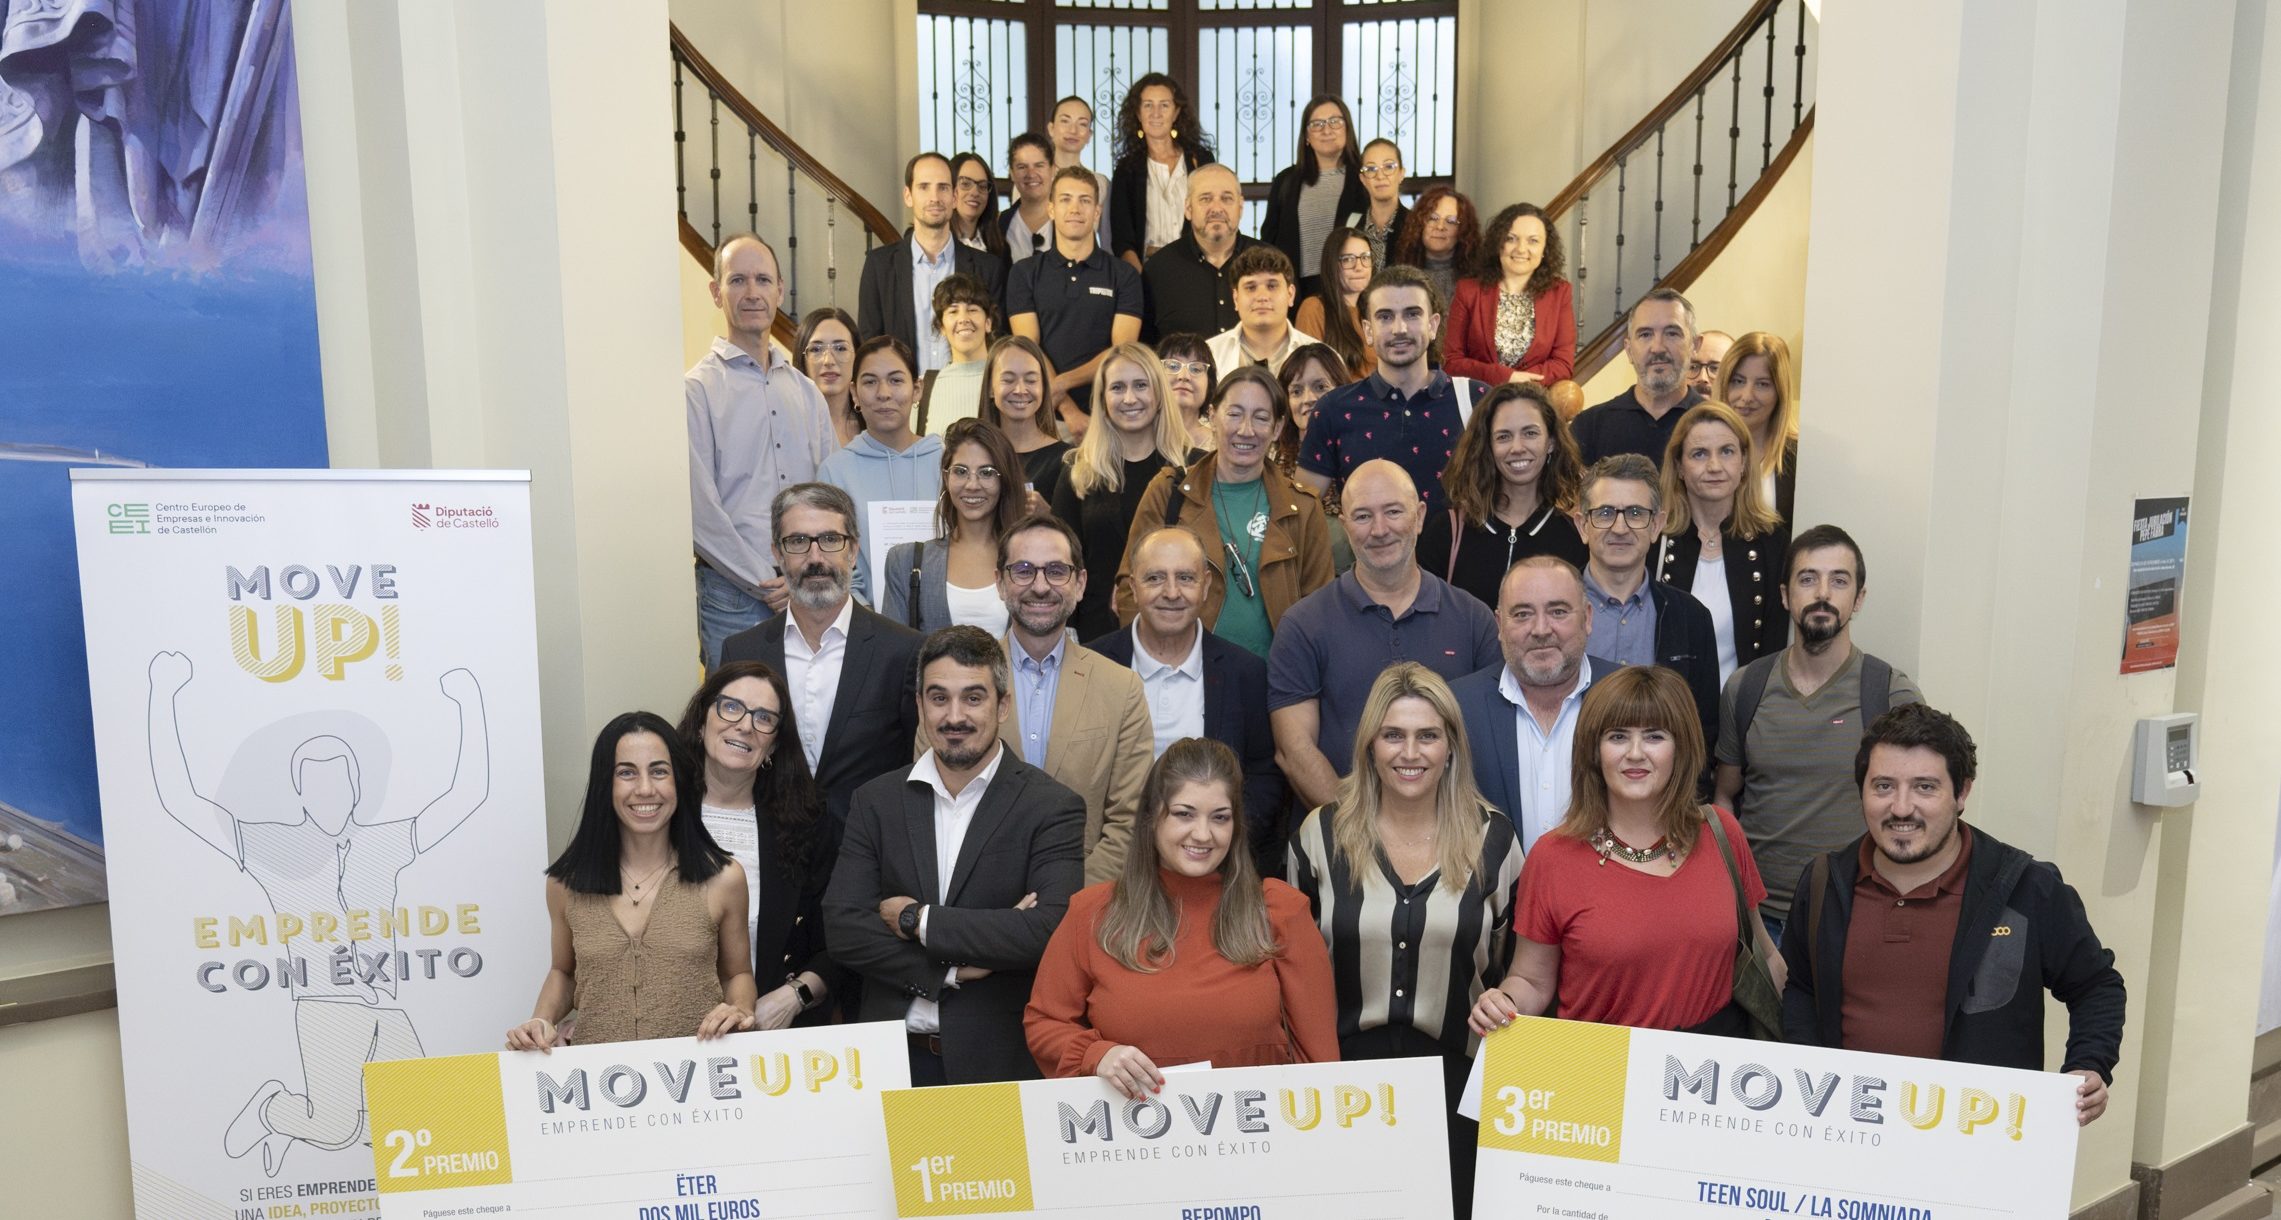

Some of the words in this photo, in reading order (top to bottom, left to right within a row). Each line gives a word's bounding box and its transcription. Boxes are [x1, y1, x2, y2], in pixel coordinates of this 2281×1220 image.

[155, 503, 189, 512] Centro
[191, 503, 232, 514] Europeo
[233, 503, 247, 512] de
[156, 514, 203, 524] Empresas
[213, 513, 265, 523] Innovación
[435, 506, 493, 518] Diputació
[157, 525, 170, 534] de
[172, 525, 217, 534] Castellón
[436, 518, 451, 528] de
[453, 517, 499, 529] Castelló
[224, 564, 399, 600] MOVE
[228, 604, 404, 684] UP!
[193, 903, 481, 948] EMPRENDE
[196, 956, 308, 993] CON
[329, 944, 483, 986] ÉXITO
[541, 1115, 638, 1136] EMPRENDE
[647, 1111, 683, 1127] CON
[692, 1106, 744, 1124] ÉXITO
[1531, 1118, 1611, 1147] PREMIO
[1659, 1108, 1764, 1133] EMPRENDE
[1774, 1121, 1815, 1139] CON
[1824, 1125, 1883, 1147] ÉXITO
[423, 1150, 499, 1176] PREMIO
[1062, 1145, 1162, 1165] EMPRENDE
[1171, 1144, 1208, 1158] CON
[1217, 1140, 1271, 1156] ÉXITO
[239, 1188, 253, 1203] SI
[257, 1184, 293, 1201] ERES
[297, 1178, 378, 1197] EMPRENDE
[676, 1173, 718, 1197] ËTER
[940, 1179, 1016, 1201] PREMIO
[1519, 1172, 1553, 1185] Páguese
[1555, 1178, 1573, 1187] este
[1574, 1179, 1604, 1192] cheque
[1605, 1184, 1611, 1192] a
[423, 1208, 456, 1219] Páguese
[457, 1206, 475, 1216] este
[476, 1204, 504, 1216] cheque
[639, 1205, 671, 1220] DOS
[675, 1203, 704, 1220] MIL
[707, 1198, 761, 1220] EUROS
[1697, 1181, 1742, 1206] TEEN
[1745, 1187, 1790, 1213] SOUL
[1794, 1194, 1807, 1214] /
[1810, 1195, 1833, 1218] LA
[235, 1207, 265, 1220] UNA
[268, 1204, 306, 1219] IDEA,
[1536, 1204, 1551, 1214] Por
[1552, 1206, 1560, 1216] la
[1561, 1208, 1597, 1220] cantidad
[1598, 1211, 1609, 1220] de
